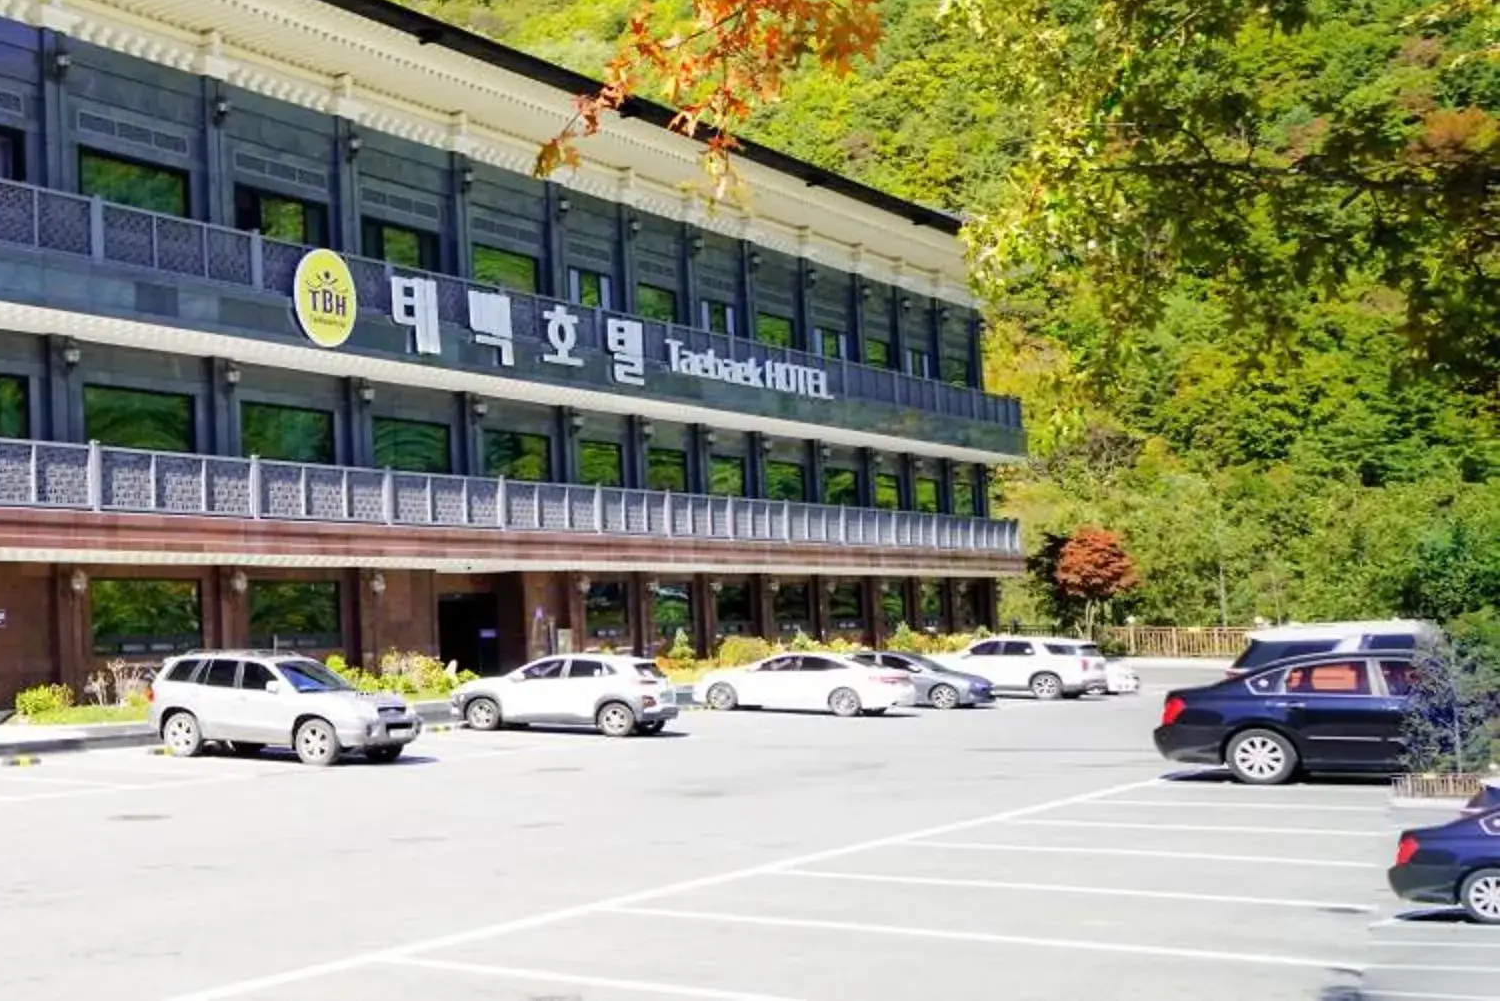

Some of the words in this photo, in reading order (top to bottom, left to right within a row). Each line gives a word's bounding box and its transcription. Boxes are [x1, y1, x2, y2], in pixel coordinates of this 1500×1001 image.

[308, 288, 347, 317] TBH
[664, 338, 764, 388] Taebaek
[765, 359, 835, 400] HOTEL
